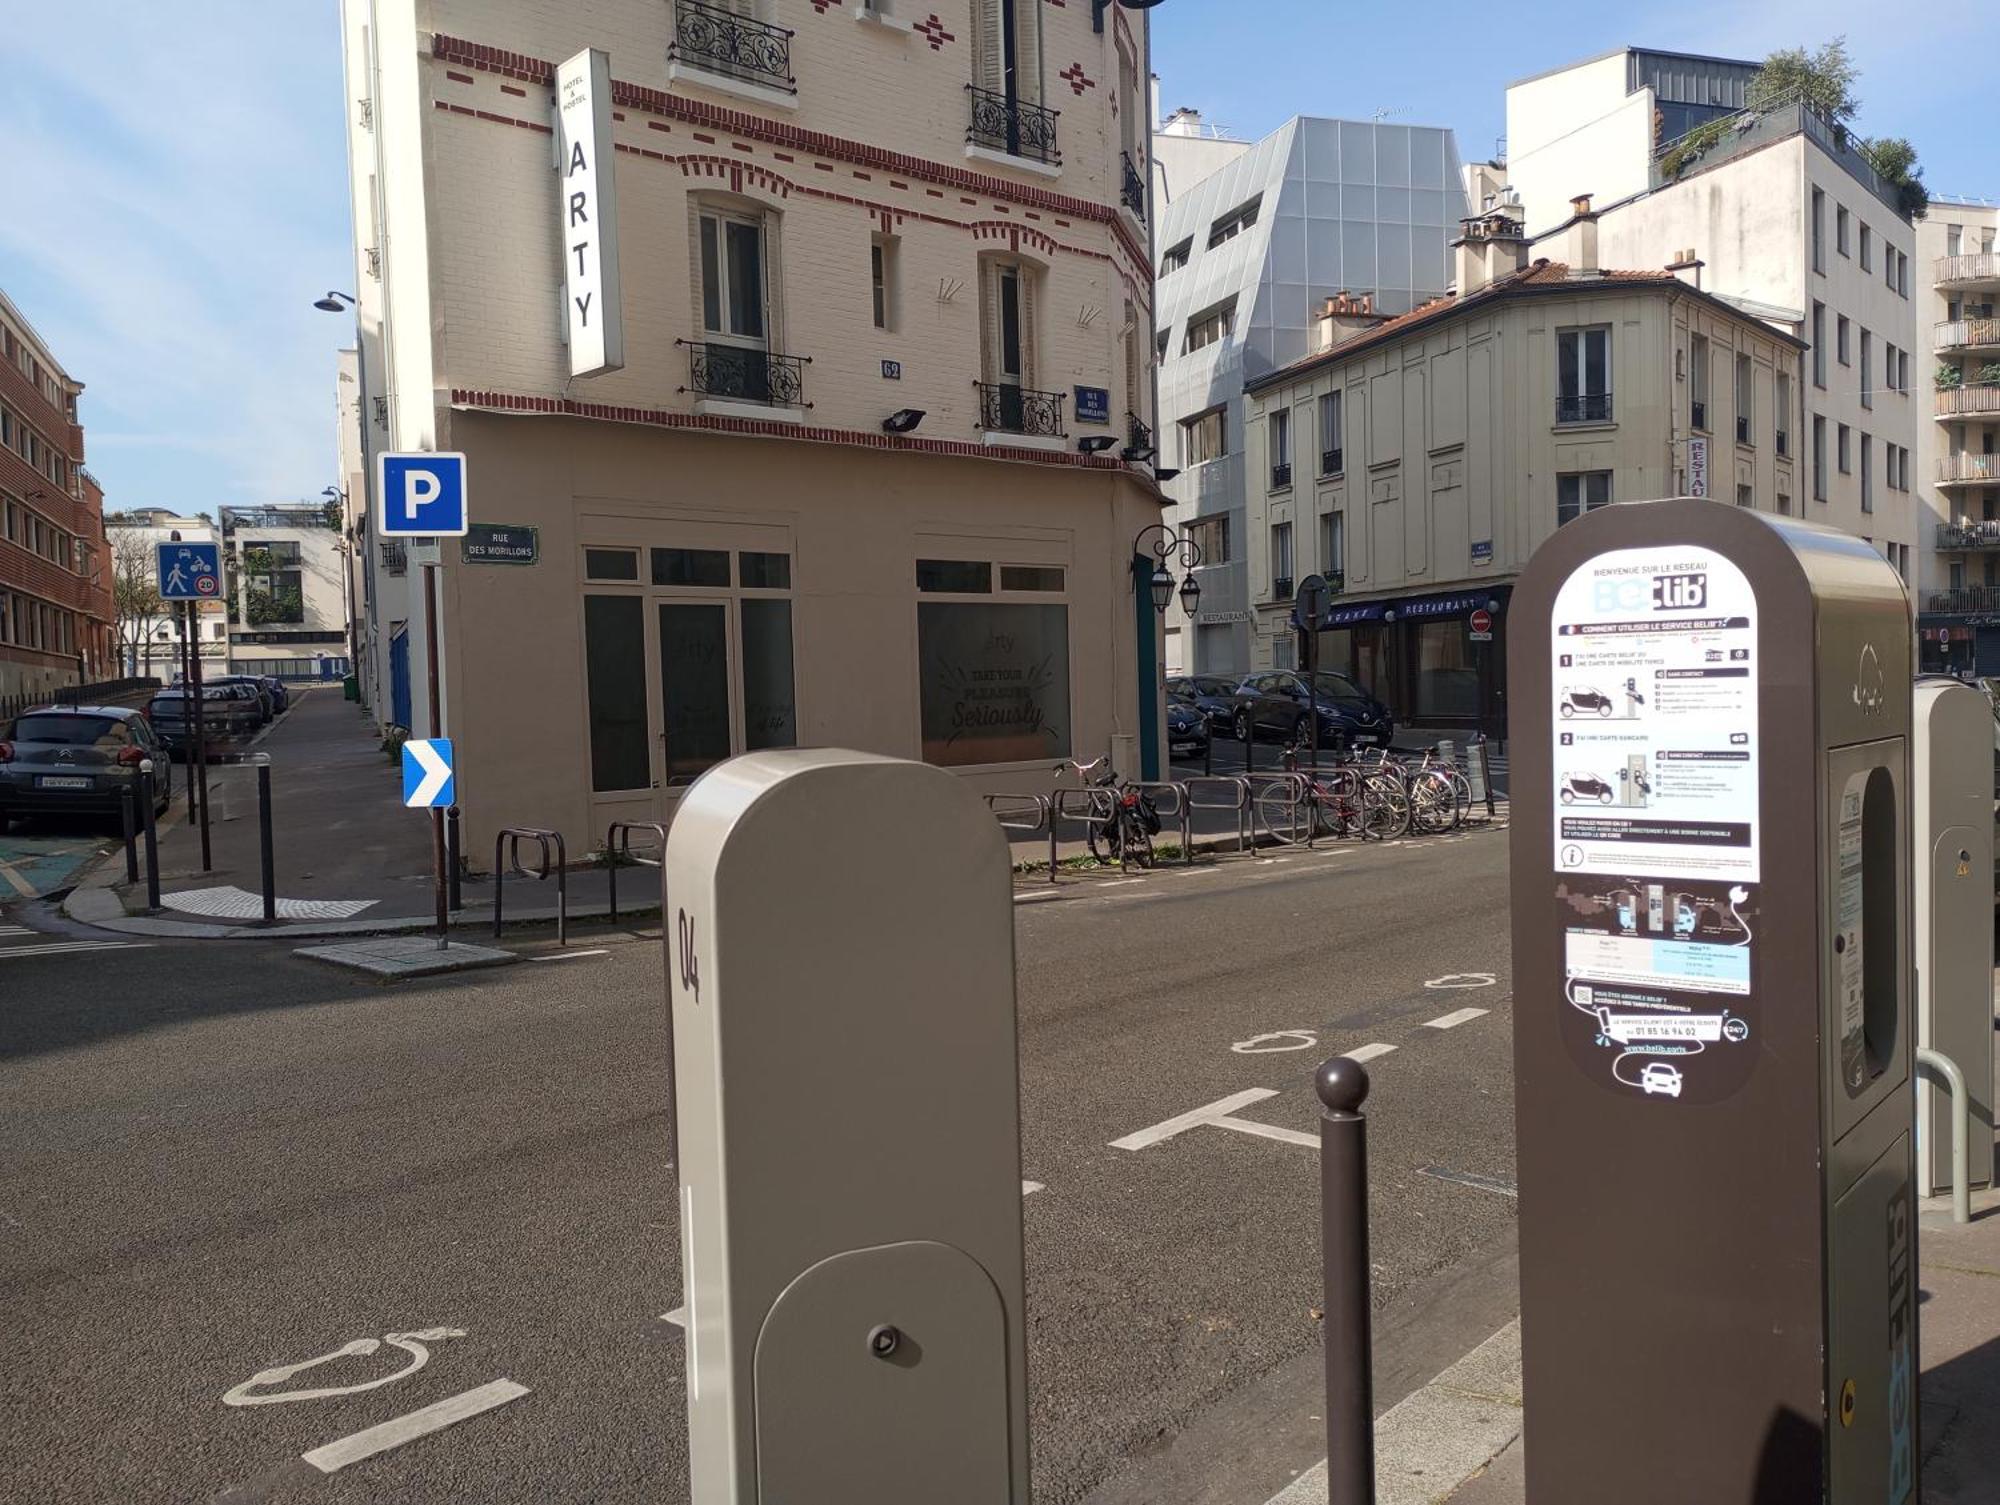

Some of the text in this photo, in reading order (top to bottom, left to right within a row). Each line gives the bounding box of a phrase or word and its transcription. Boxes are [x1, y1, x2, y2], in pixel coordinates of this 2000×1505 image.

[563, 76, 583, 92] HOTEL
[563, 94, 587, 113] HOSTEL
[568, 140, 591, 328] ARTY
[883, 362, 899, 378] 62
[405, 470, 441, 519] P
[492, 533, 508, 543] RUE
[469, 545, 532, 557] DES MORILLONS
[1594, 566, 1640, 577] BIENVENUE
[1642, 564, 1657, 574] SUR
[1660, 563, 1671, 573] LE
[200, 580, 212, 589] 20
[1406, 599, 1474, 614] RESTAURANT
[1203, 612, 1250, 622] RESTAURANT
[1582, 624, 1617, 633] COMMENT
[1618, 623, 1650, 632] UTILISER
[1652, 623, 1660, 631] LE
[1662, 621, 1693, 630] SERVICE
[952, 699, 1044, 734] Seriously
[679, 907, 699, 1005] 04
[1636, 1027, 1645, 1035] 01
[1647, 1027, 1657, 1035] 85
[1685, 1028, 1696, 1036] 02
